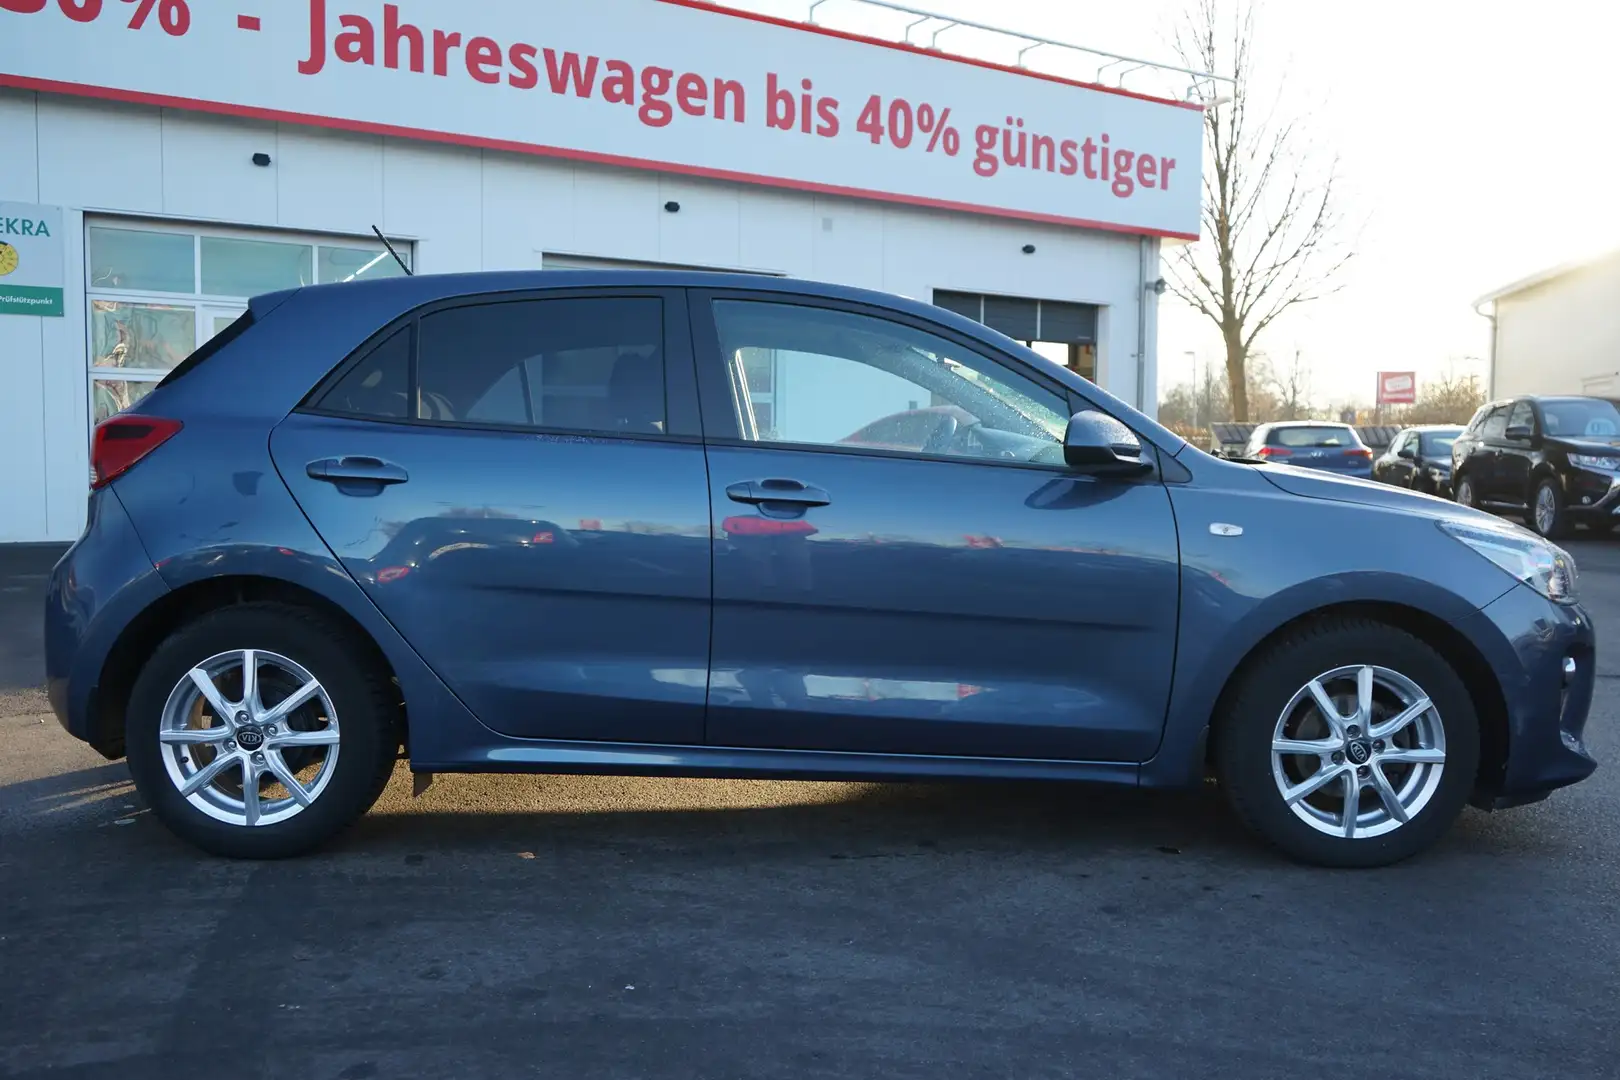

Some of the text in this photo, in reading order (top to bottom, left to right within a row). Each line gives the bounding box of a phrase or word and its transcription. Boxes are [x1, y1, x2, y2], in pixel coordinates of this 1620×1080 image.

[298, 0, 745, 127] Jahreswagen
[766, 73, 839, 137] bis
[857, 94, 960, 156] 40%
[974, 116, 1177, 198] günstiger
